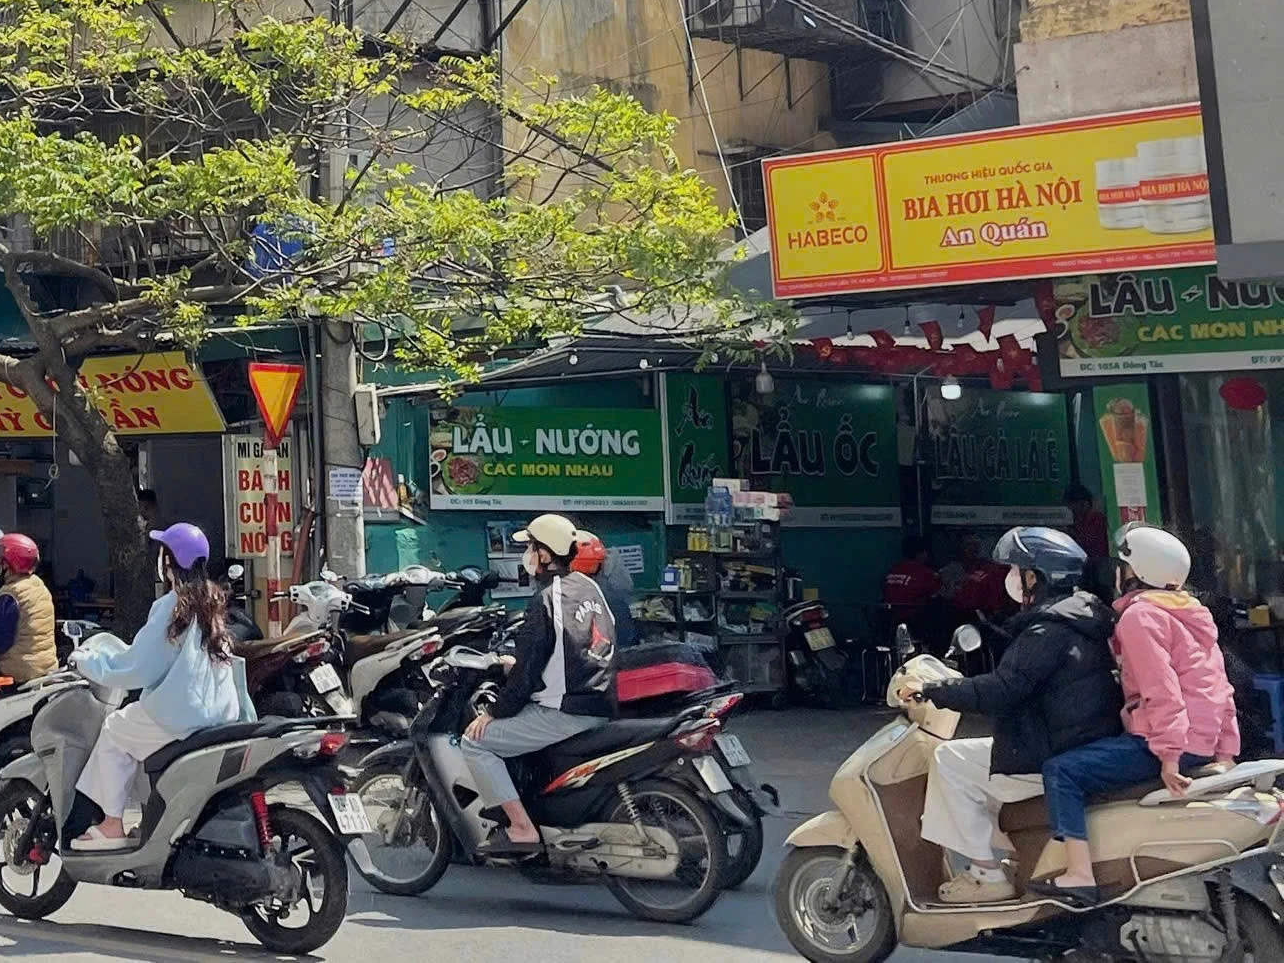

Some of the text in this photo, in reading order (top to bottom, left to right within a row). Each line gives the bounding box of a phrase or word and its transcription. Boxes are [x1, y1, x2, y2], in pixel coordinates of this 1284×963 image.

[999, 160, 1031, 175] QUỐC
[1033, 162, 1053, 172] GIA
[902, 176, 1083, 221] BIA HƠI HÀ NỘI
[787, 225, 868, 250] HABECO
[940, 217, 1049, 247] An Quán
[100, 398, 162, 431] ẦN
[452, 413, 513, 454] LẨU
[535, 424, 641, 456] NƯỚNG
[750, 406, 880, 477] LẨU ỐC
[238, 464, 291, 491] BÁH
[239, 501, 292, 523] CUN
[240, 526, 293, 553] NÓG
[575, 599, 603, 623] PARIS
